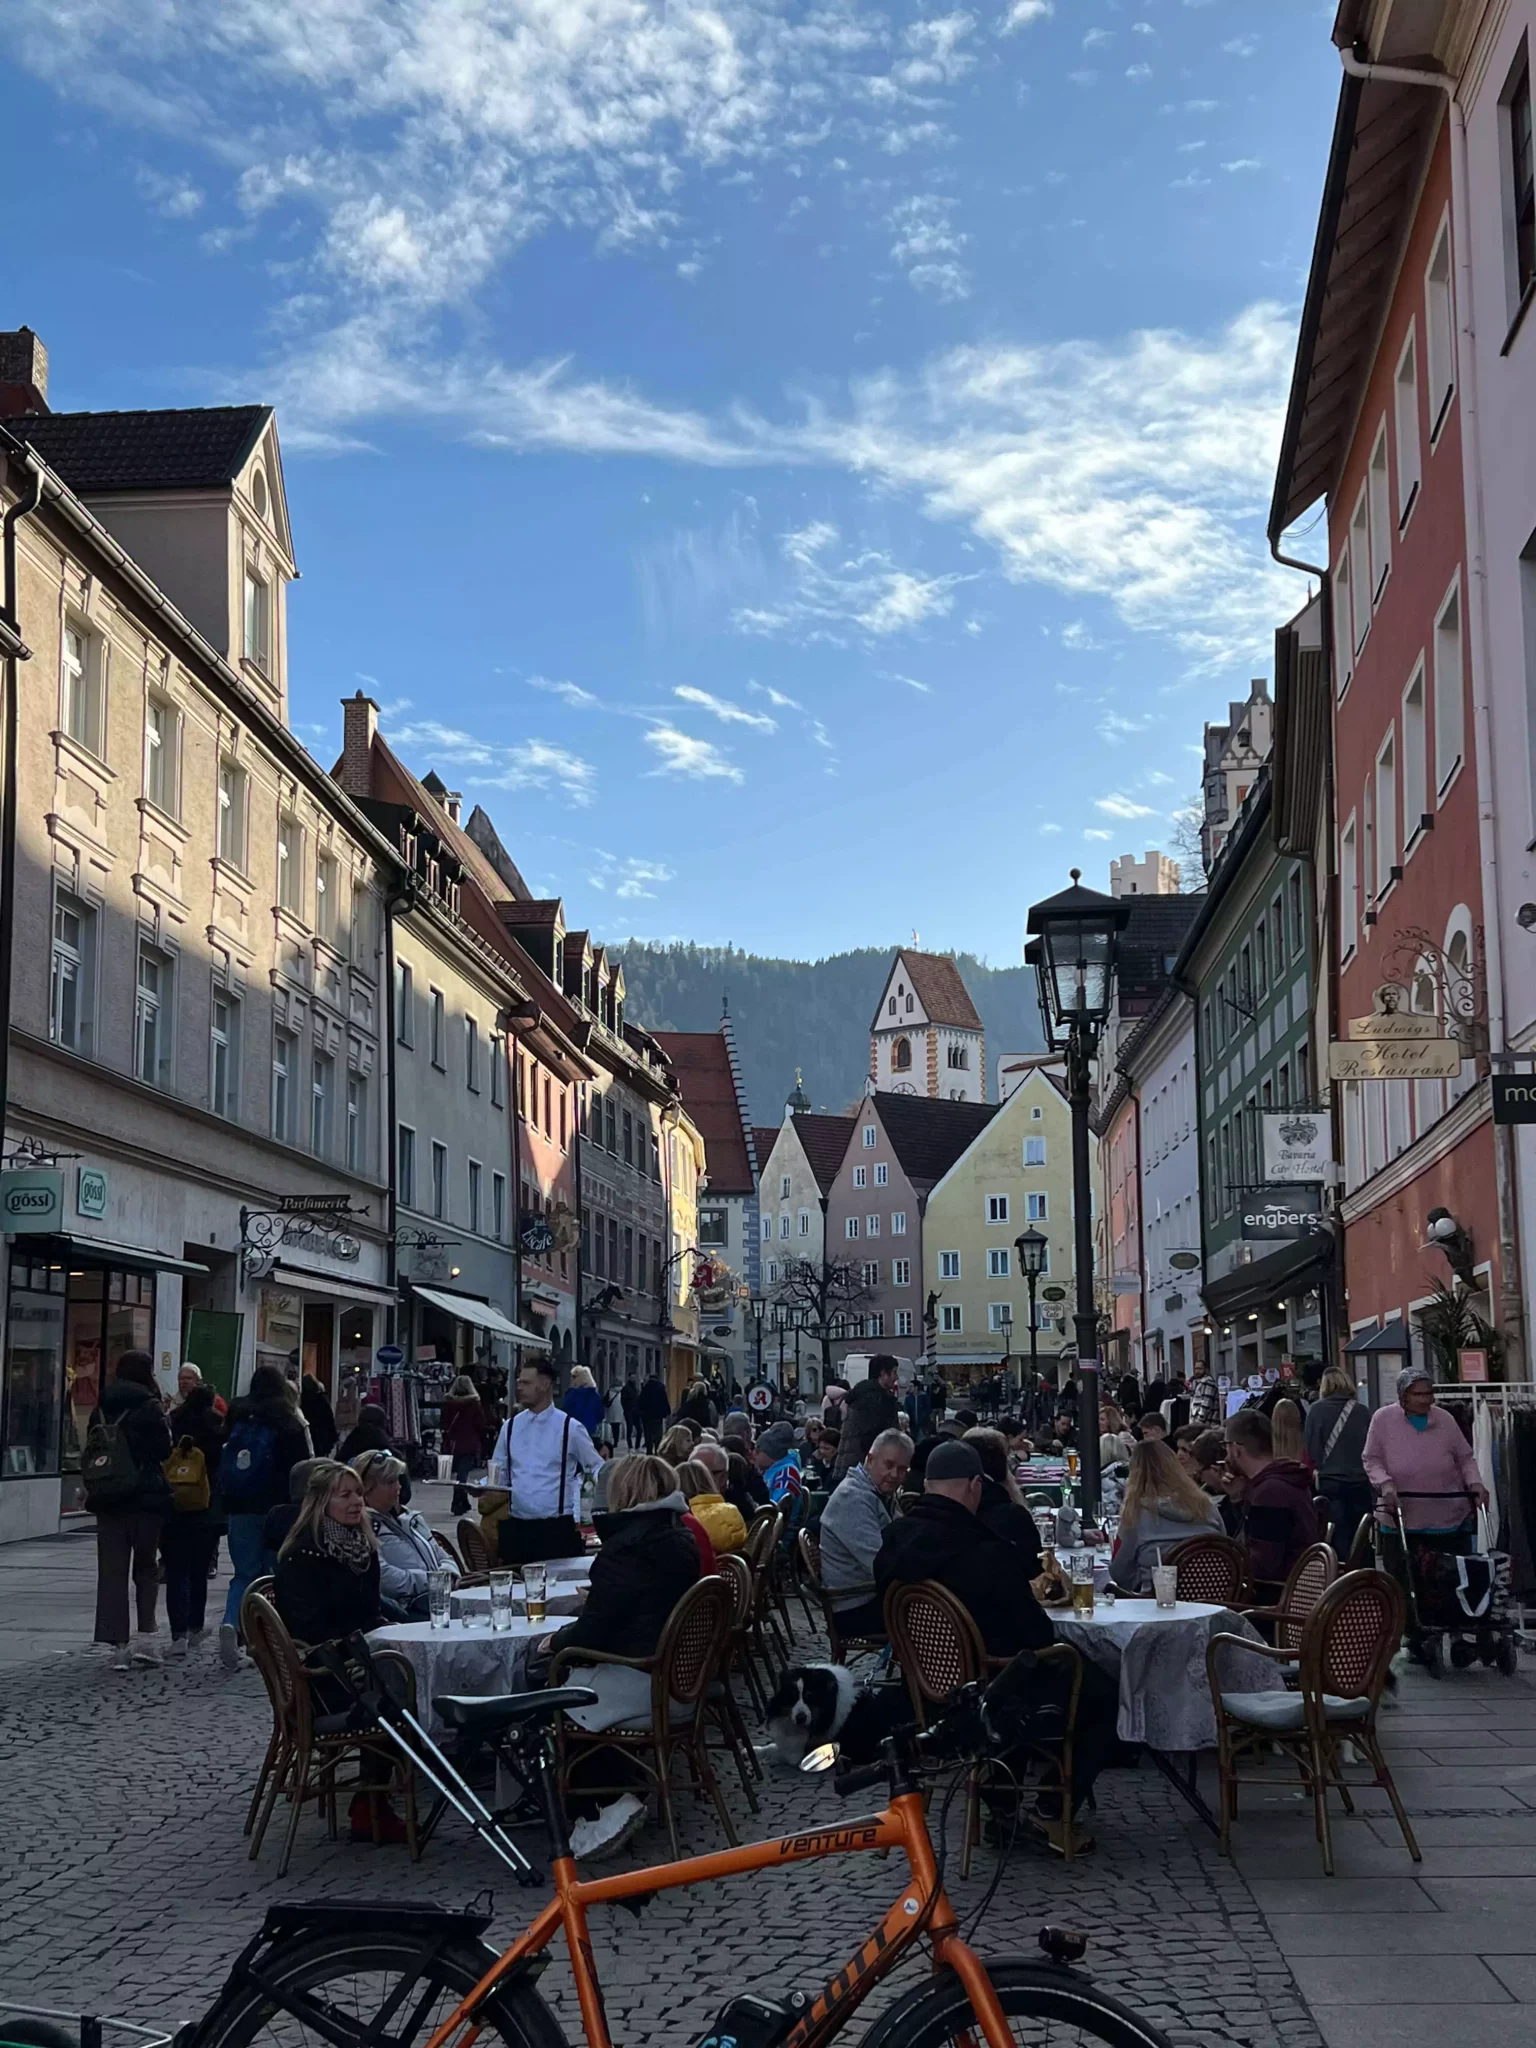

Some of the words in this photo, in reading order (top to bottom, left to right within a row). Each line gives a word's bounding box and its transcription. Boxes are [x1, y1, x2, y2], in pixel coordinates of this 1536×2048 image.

[1355, 1020, 1431, 1035] Ludwigs
[1360, 1043, 1430, 1061] Hotel
[1336, 1060, 1456, 1077] Restaurant
[11, 1193, 49, 1211] gössl
[283, 1196, 346, 1210] Parfümerie
[1244, 1210, 1318, 1229] engbers
